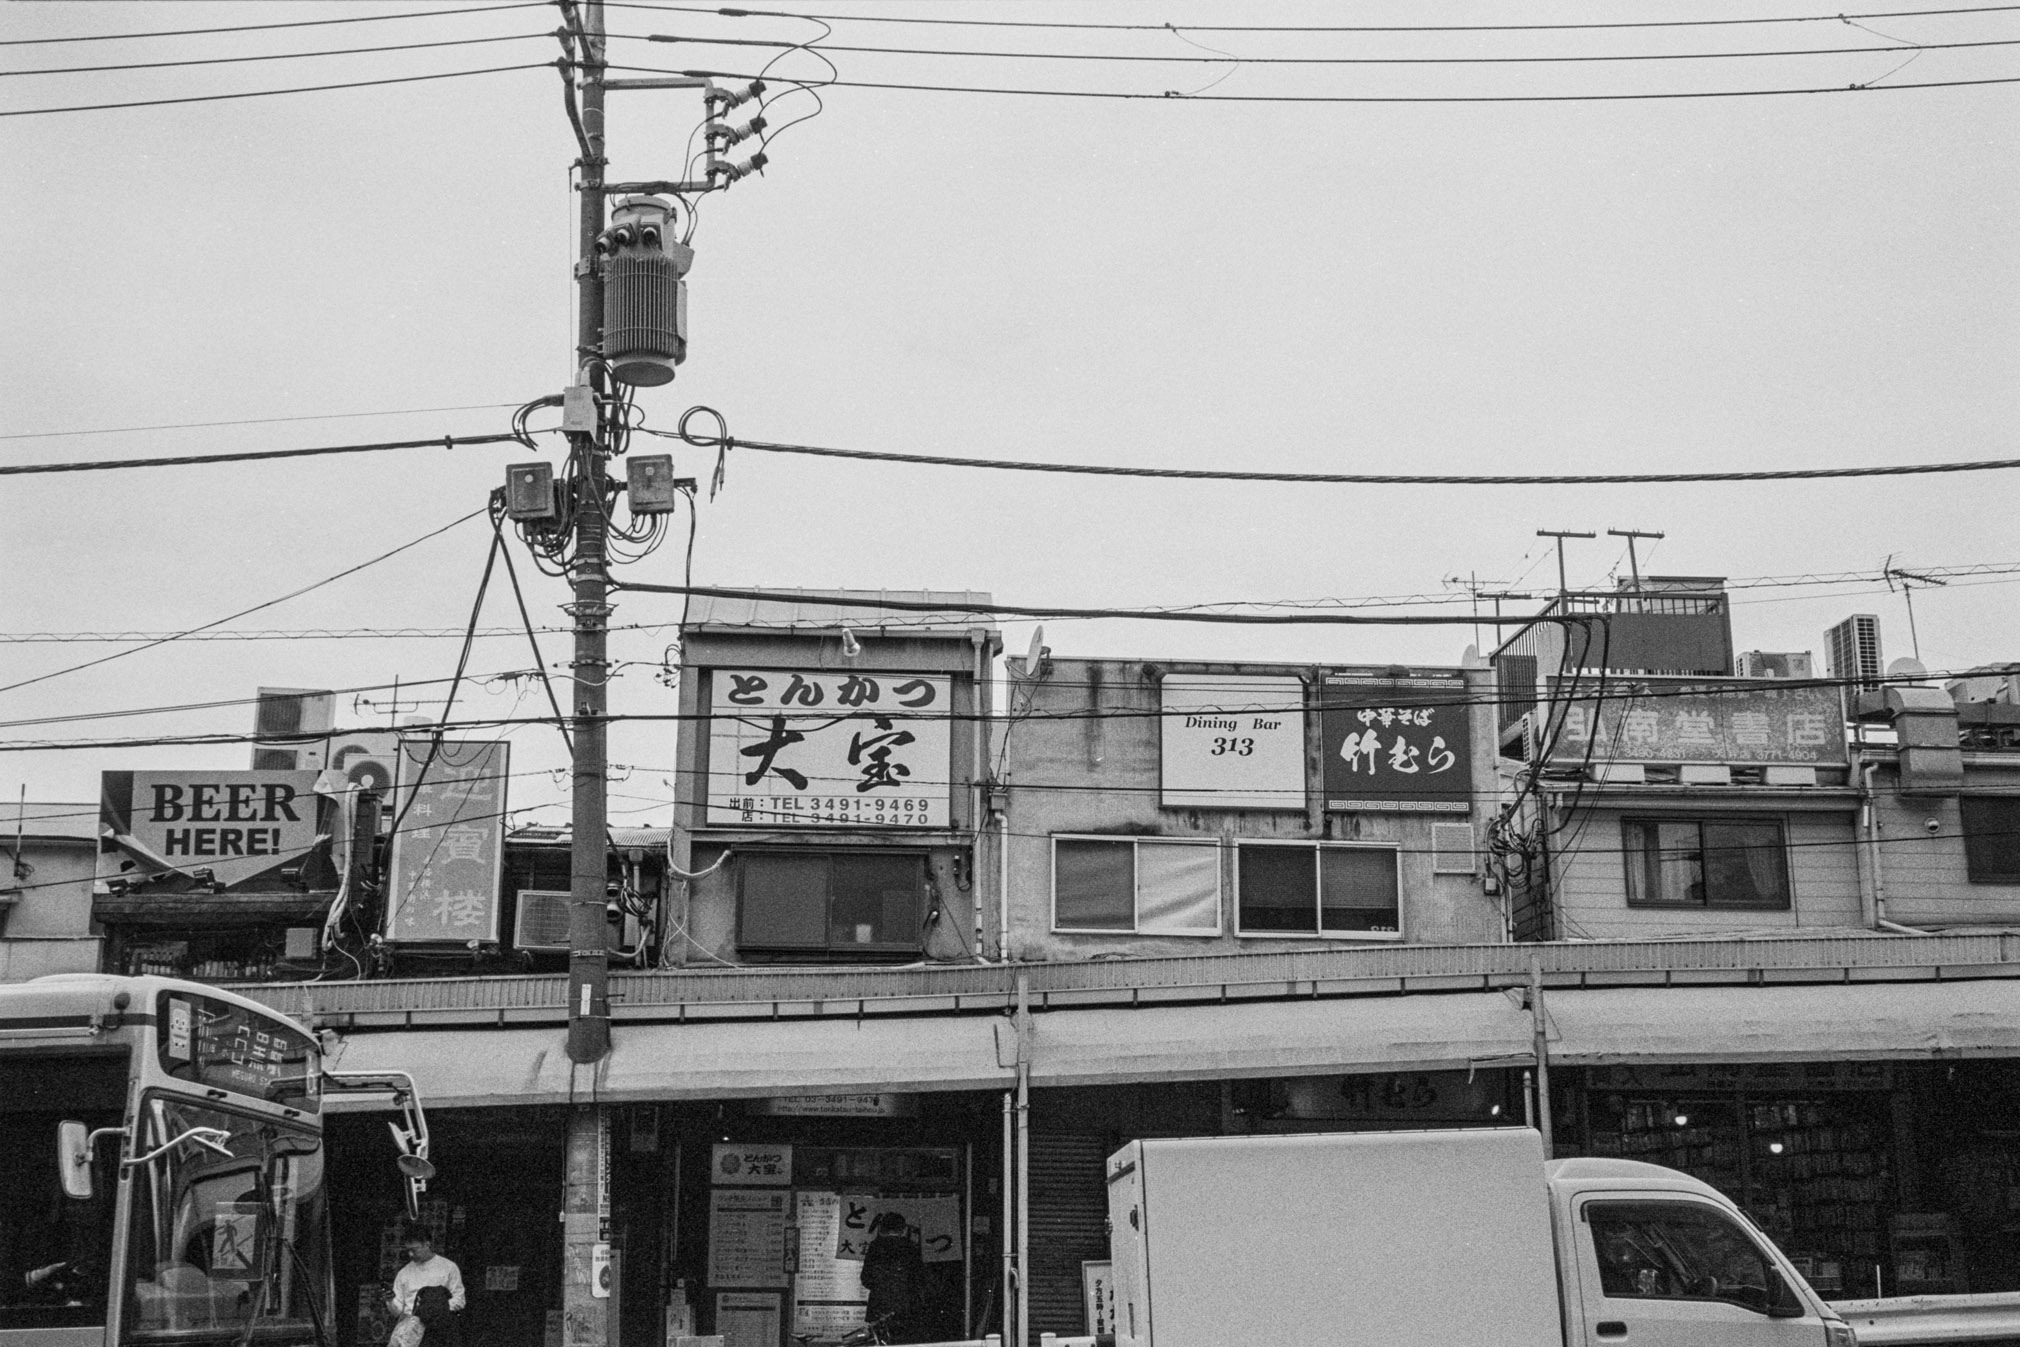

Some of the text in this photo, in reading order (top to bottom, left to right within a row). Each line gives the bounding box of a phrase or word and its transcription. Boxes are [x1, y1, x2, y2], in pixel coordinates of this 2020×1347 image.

[728, 672, 936, 708] とんかつ
[1185, 716, 1281, 732] Dining Bar
[1356, 707, 1435, 728] 中華そば
[740, 713, 916, 794] 大宝
[1210, 737, 1255, 756] 313
[1340, 728, 1455, 775] 竹むら
[149, 784, 301, 822] BEER
[770, 797, 805, 810] TEL
[811, 797, 929, 811] 3491-9469
[771, 812, 801, 823] TEL
[811, 812, 929, 824] 3491-9470
[165, 828, 280, 856] HERE!
[805, 1095, 879, 1104] 03-3491-947
